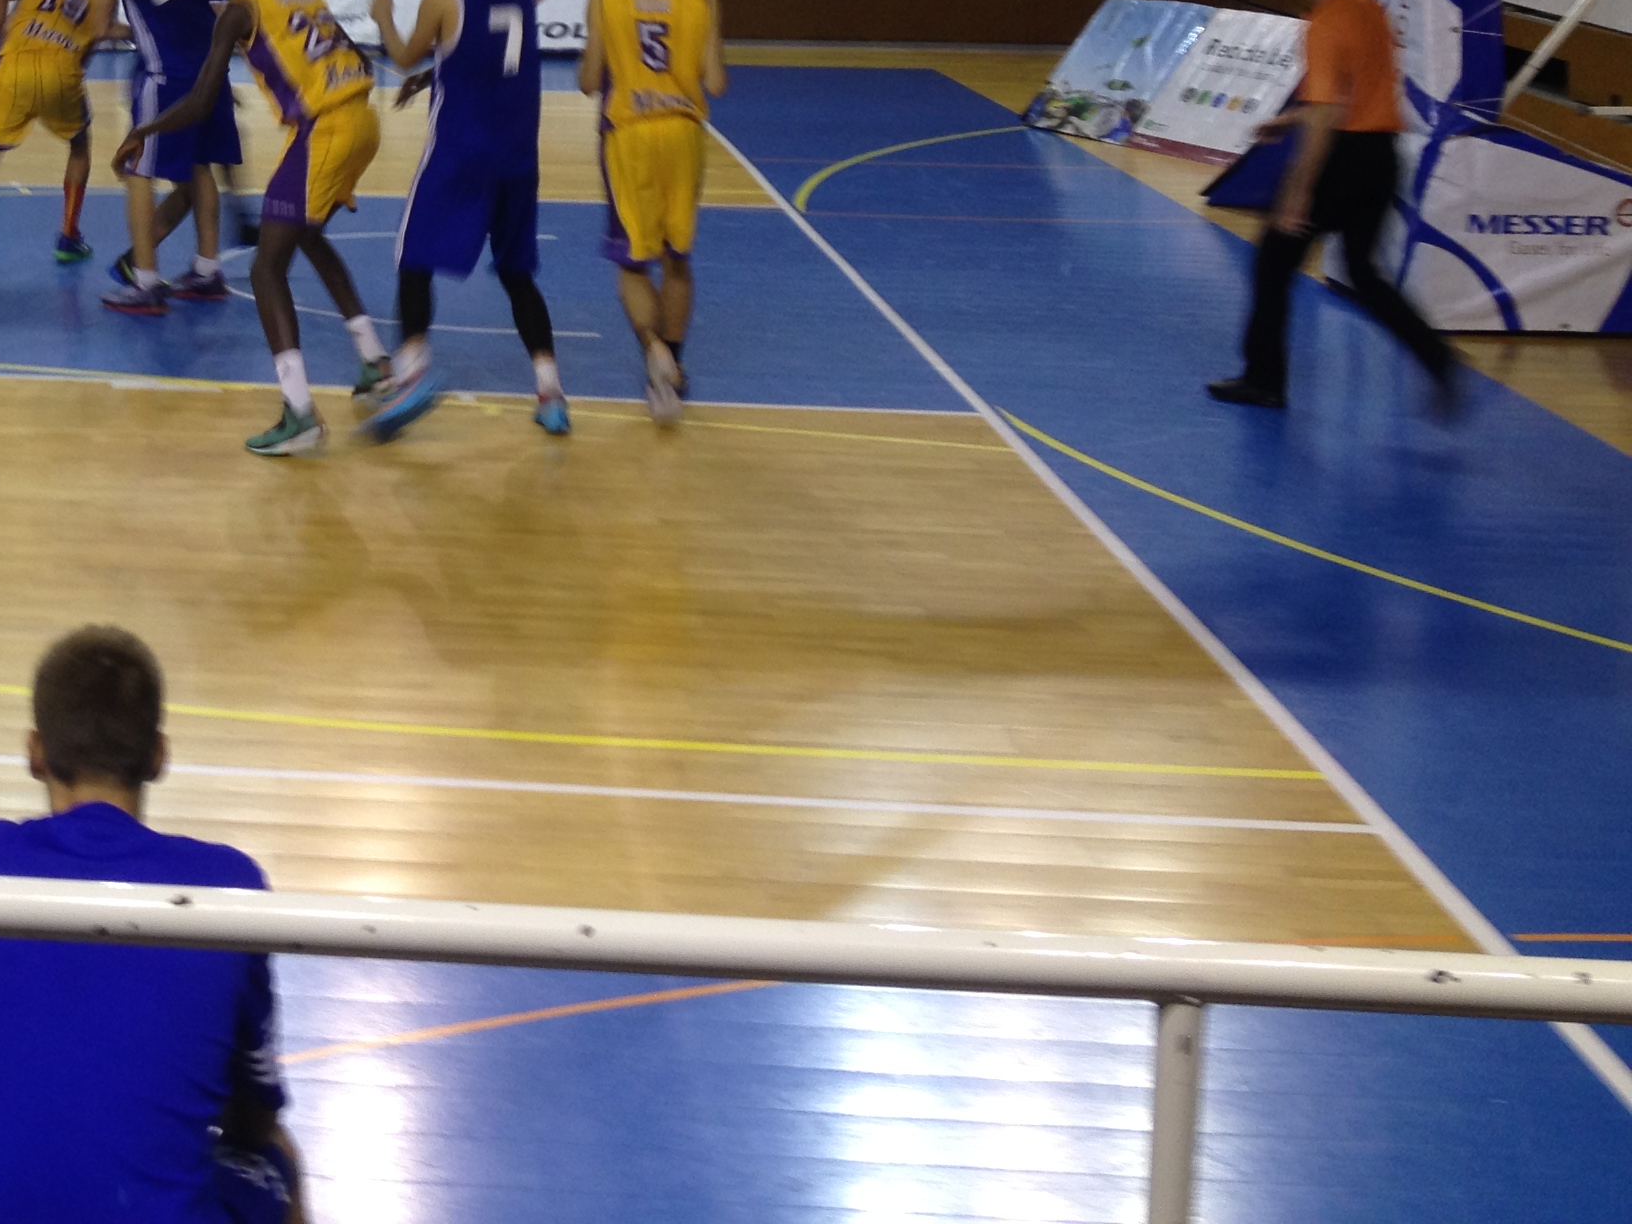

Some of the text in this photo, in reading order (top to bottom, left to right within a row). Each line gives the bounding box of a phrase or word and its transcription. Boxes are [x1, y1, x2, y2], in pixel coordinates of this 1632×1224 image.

[488, 4, 524, 77] 7
[635, 19, 670, 74] 5
[1466, 213, 1611, 236] MESSER
